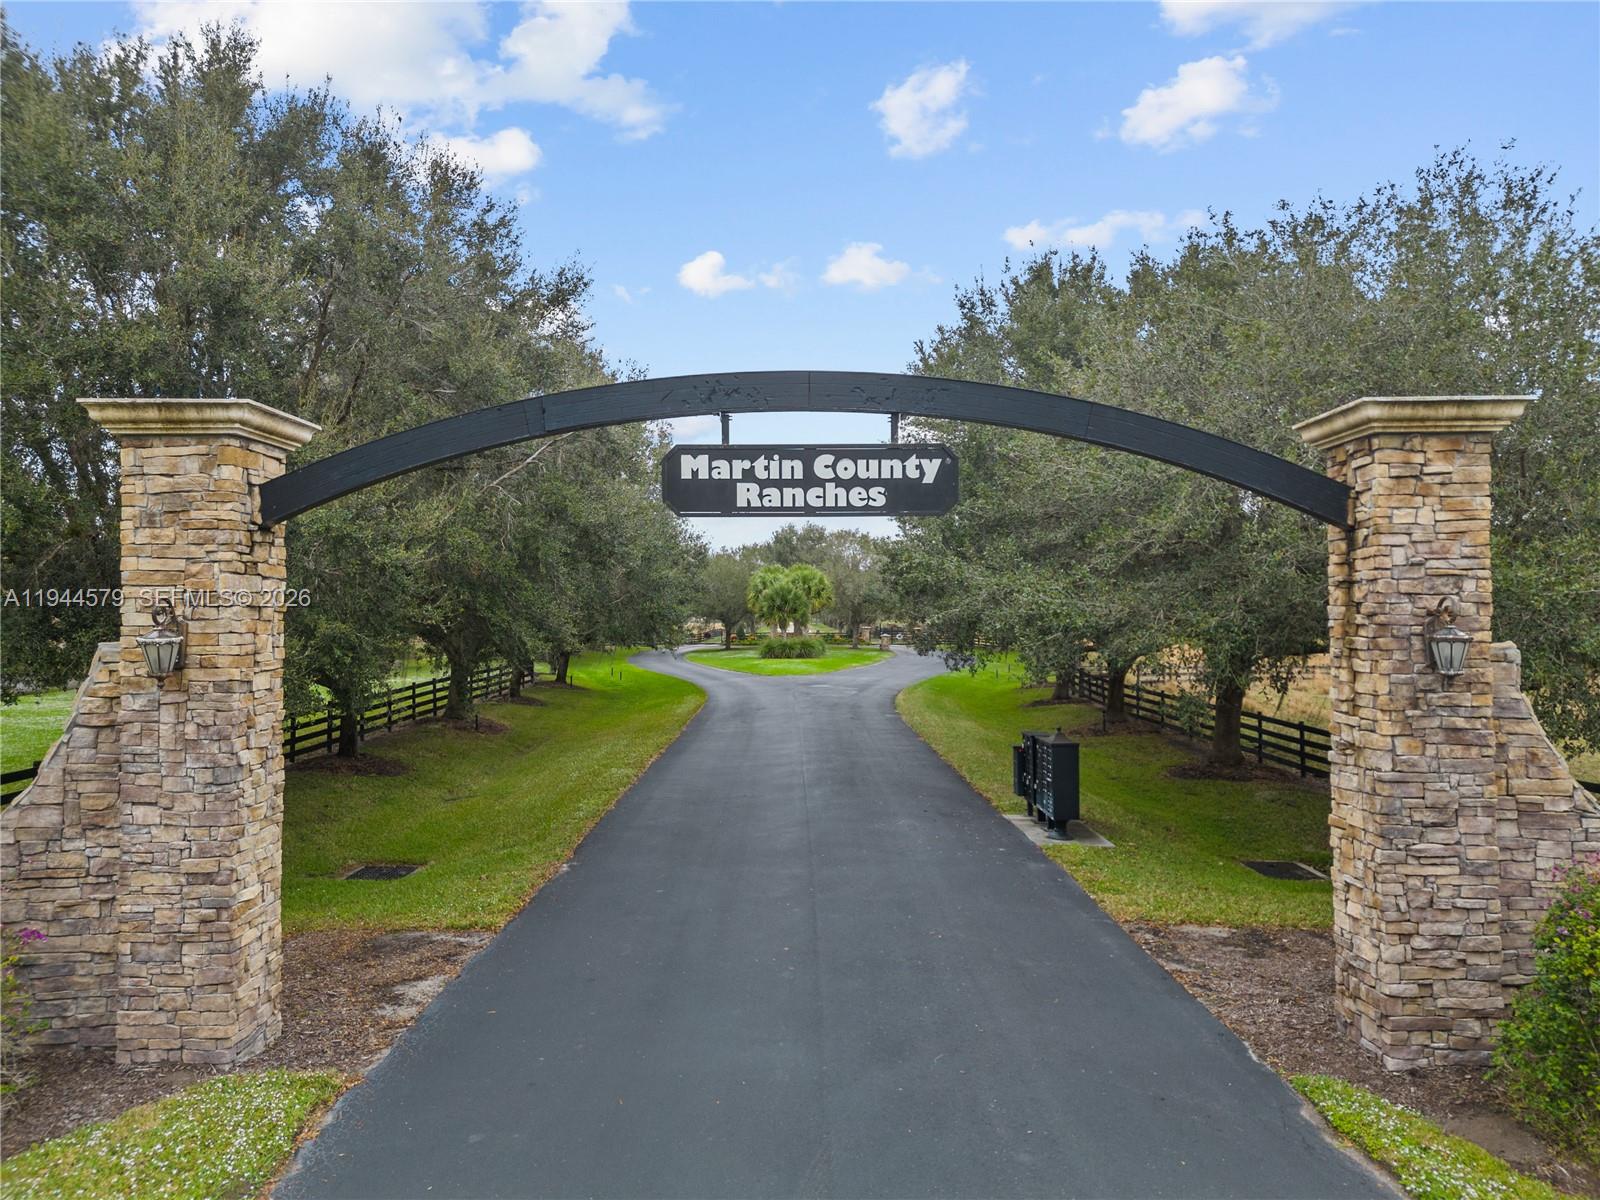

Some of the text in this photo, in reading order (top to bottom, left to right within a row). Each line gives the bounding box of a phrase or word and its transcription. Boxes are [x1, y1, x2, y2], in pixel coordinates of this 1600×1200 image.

[680, 453, 942, 484] Martin County
[736, 482, 887, 508] Ranches
